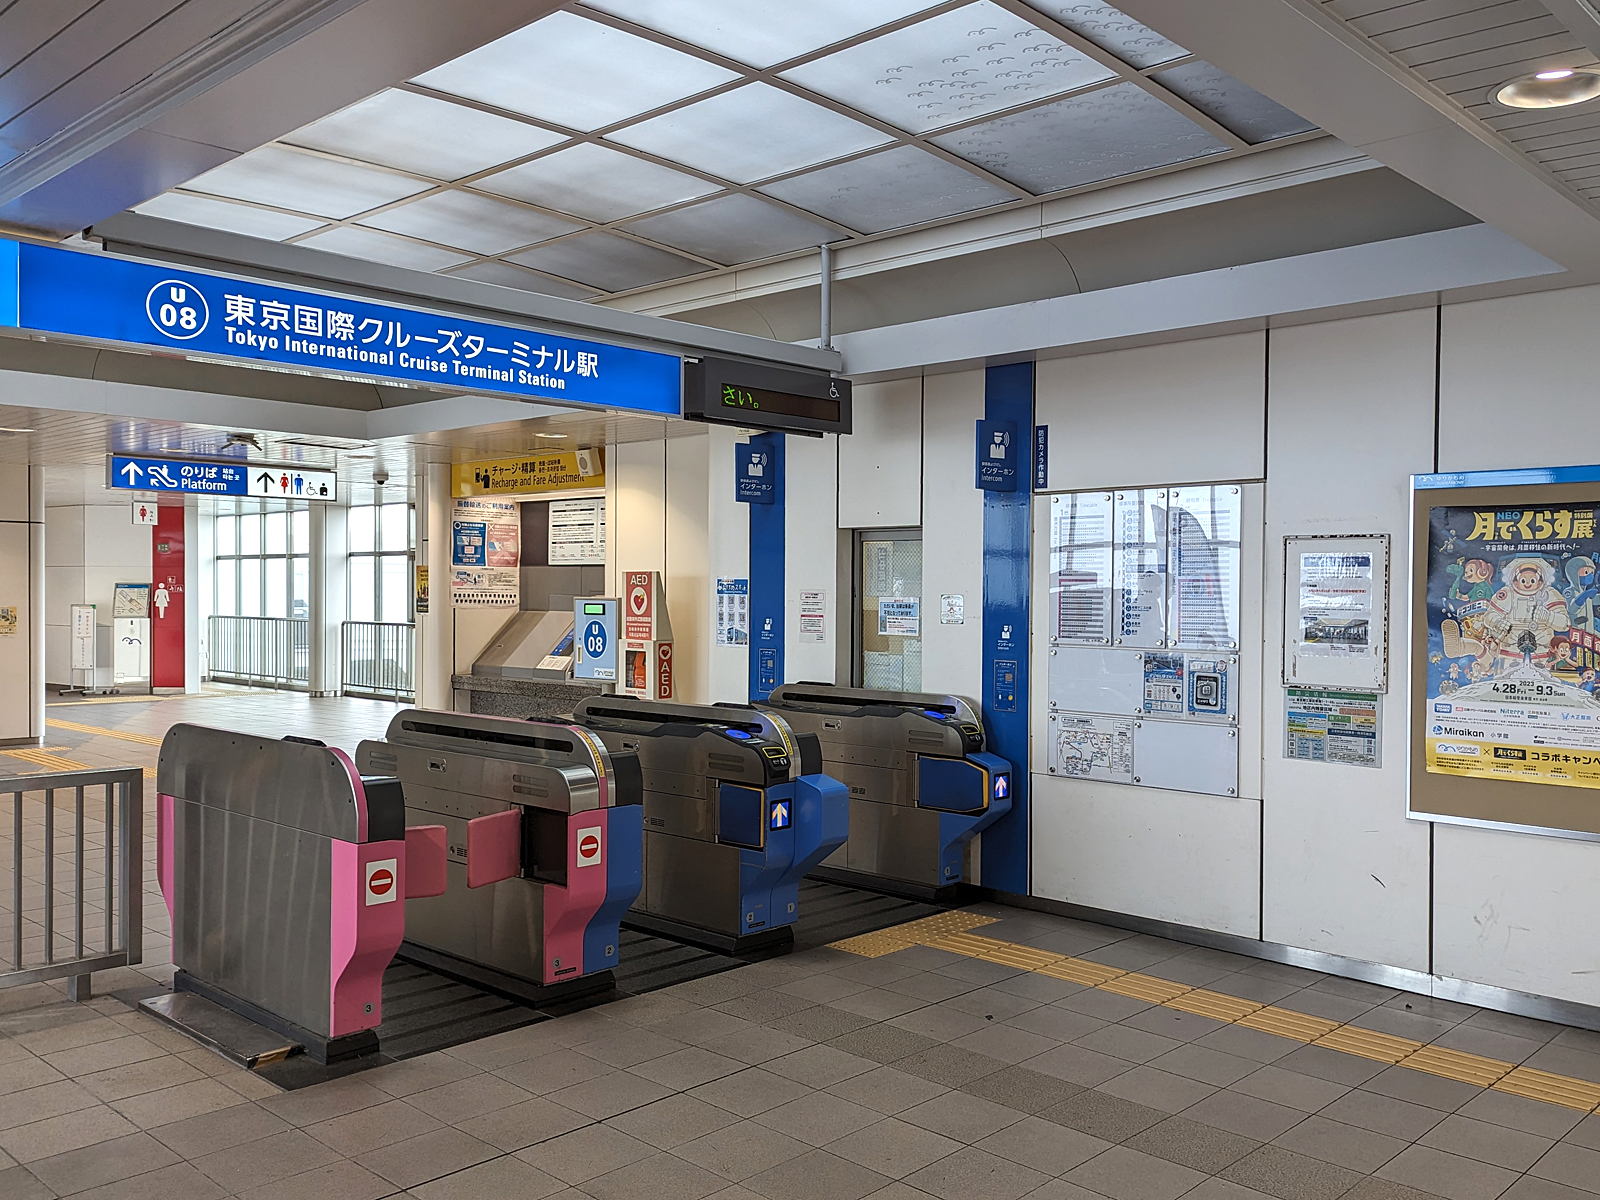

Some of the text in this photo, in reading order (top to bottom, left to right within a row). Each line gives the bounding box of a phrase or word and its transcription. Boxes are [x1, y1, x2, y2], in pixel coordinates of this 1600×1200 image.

[170, 286, 186, 303] U
[159, 303, 197, 330] 08
[224, 294, 599, 378] 東京国際クルーズターミナル駅
[224, 325, 566, 390] Tokyo International Cruise Terminal Station
[723, 386, 759, 409] さい。
[180, 466, 218, 479] のりば
[491, 461, 536, 476] チャージ・精算
[981, 467, 1014, 476] インターホン
[181, 477, 227, 491] Platform
[491, 477, 518, 490] Recharge
[520, 475, 531, 487] and
[533, 475, 546, 486] Fare
[981, 474, 1003, 482] Intercom
[740, 483, 772, 491] インターホン
[1497, 512, 1521, 520] NEO
[630, 574, 648, 585] AED
[1462, 602, 1482, 614] コンビニ
[592, 624, 599, 635] U
[588, 636, 603, 653] 08
[660, 661, 670, 697] AED
[1492, 683, 1517, 694] 4.28
[1536, 685, 1553, 696] 9.3
[1500, 708, 1525, 716] Niterra
[1444, 727, 1485, 738] Miraikan
[606, 946, 612, 954] 2
[554, 959, 560, 967] 3
[366, 1004, 372, 1013] 3
